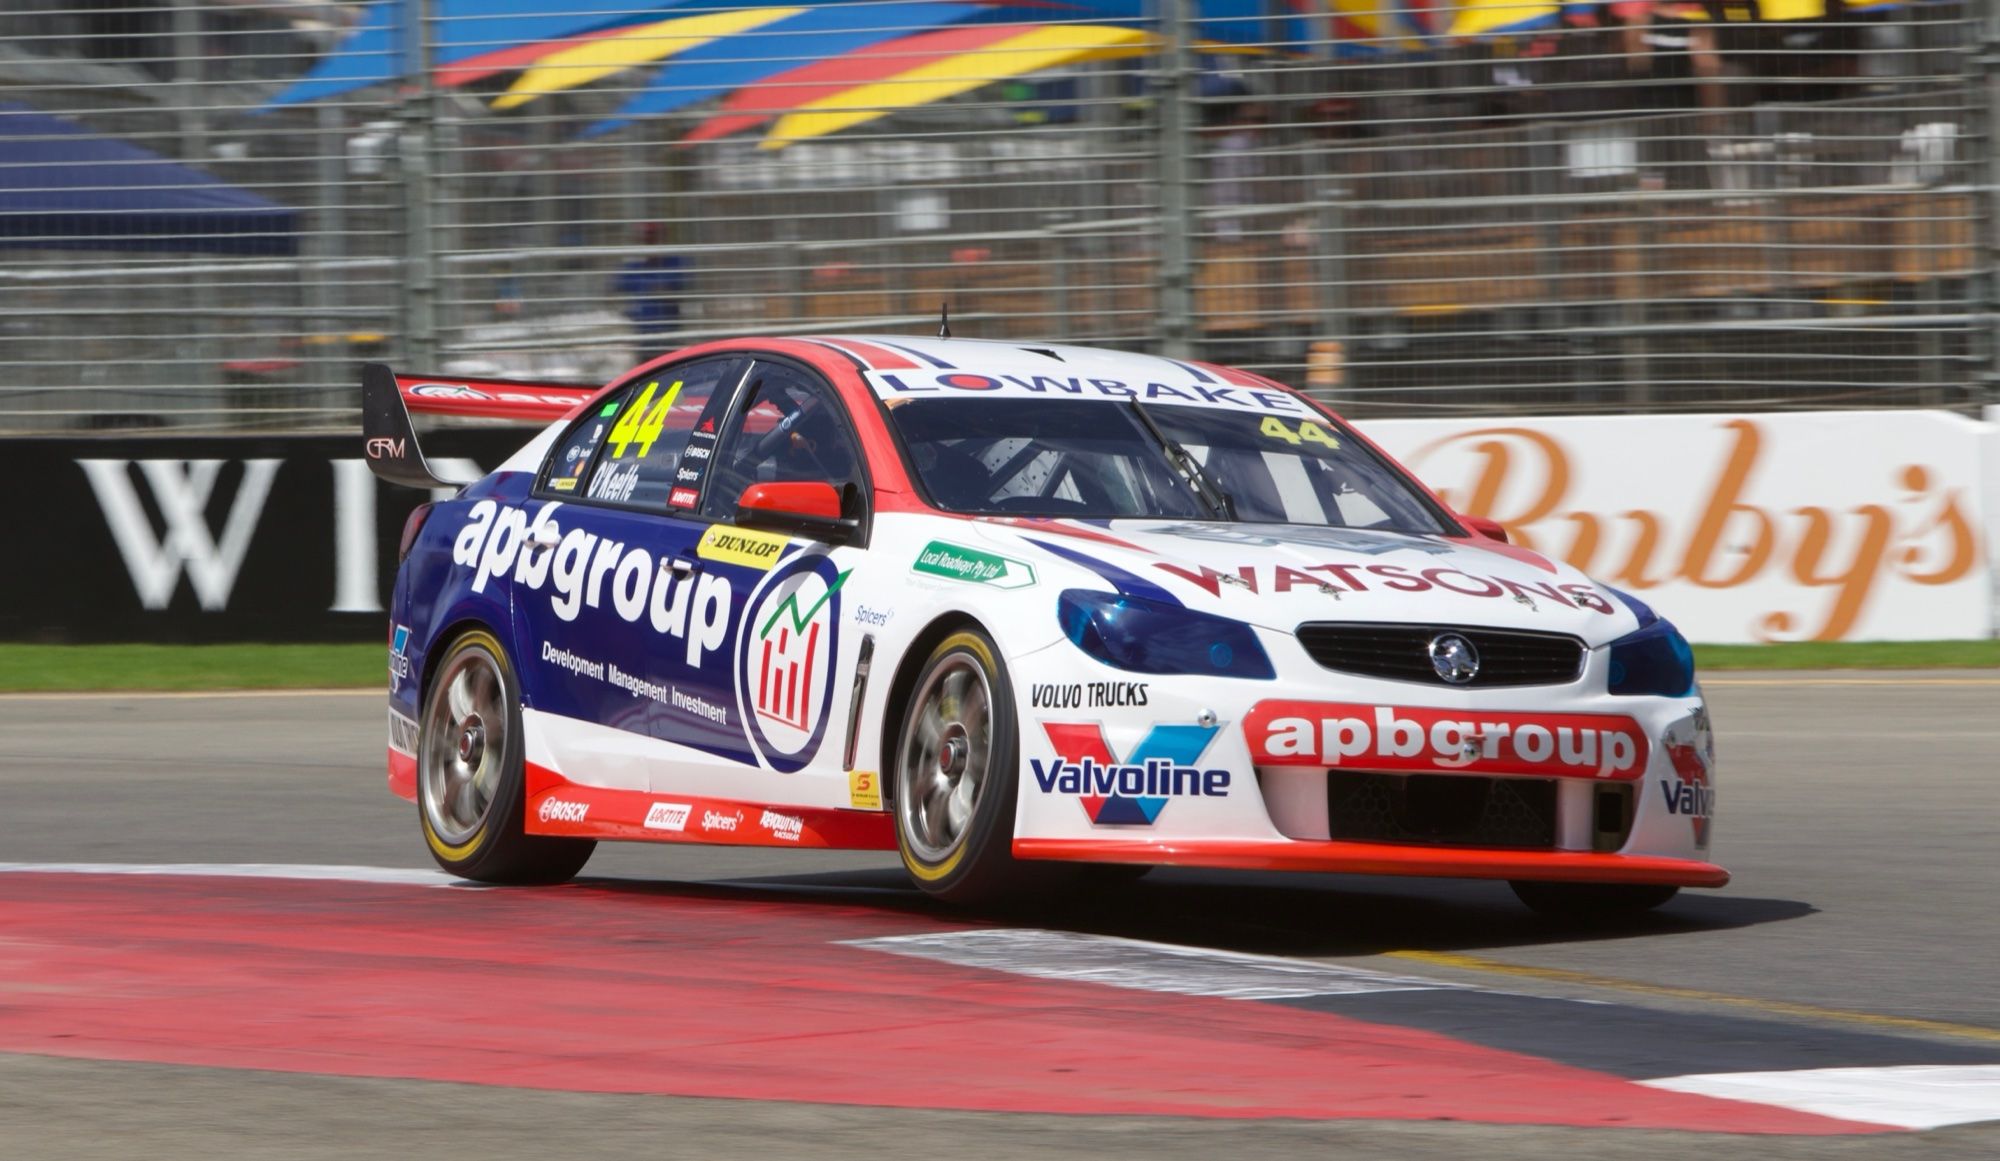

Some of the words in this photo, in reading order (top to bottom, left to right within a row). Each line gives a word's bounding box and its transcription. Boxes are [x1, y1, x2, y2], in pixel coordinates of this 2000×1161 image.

[881, 374, 1303, 413] LOWBAKE
[608, 381, 684, 458] 44
[1260, 416, 1341, 449] 44
[715, 534, 780, 557] DUNLOP
[1405, 418, 1977, 643] Ruby's
[920, 548, 944, 565] Local
[971, 560, 986, 579] Pty
[982, 563, 1003, 578] Ltd
[453, 499, 732, 668] apbgroup
[1153, 562, 1615, 615] WATSONS
[855, 605, 887, 627] Spicers
[542, 640, 604, 681] Development
[608, 663, 667, 703] Management
[671, 685, 727, 725] Investment
[1032, 683, 1081, 708] VOLVO
[1088, 682, 1149, 707] TRUCKS
[1264, 707, 1637, 777] apbgroup
[1030, 759, 1231, 797] Valvoline
[550, 801, 590, 822] BOSCH
[649, 808, 687, 825] LOCTITE
[701, 811, 738, 832] Spicers
